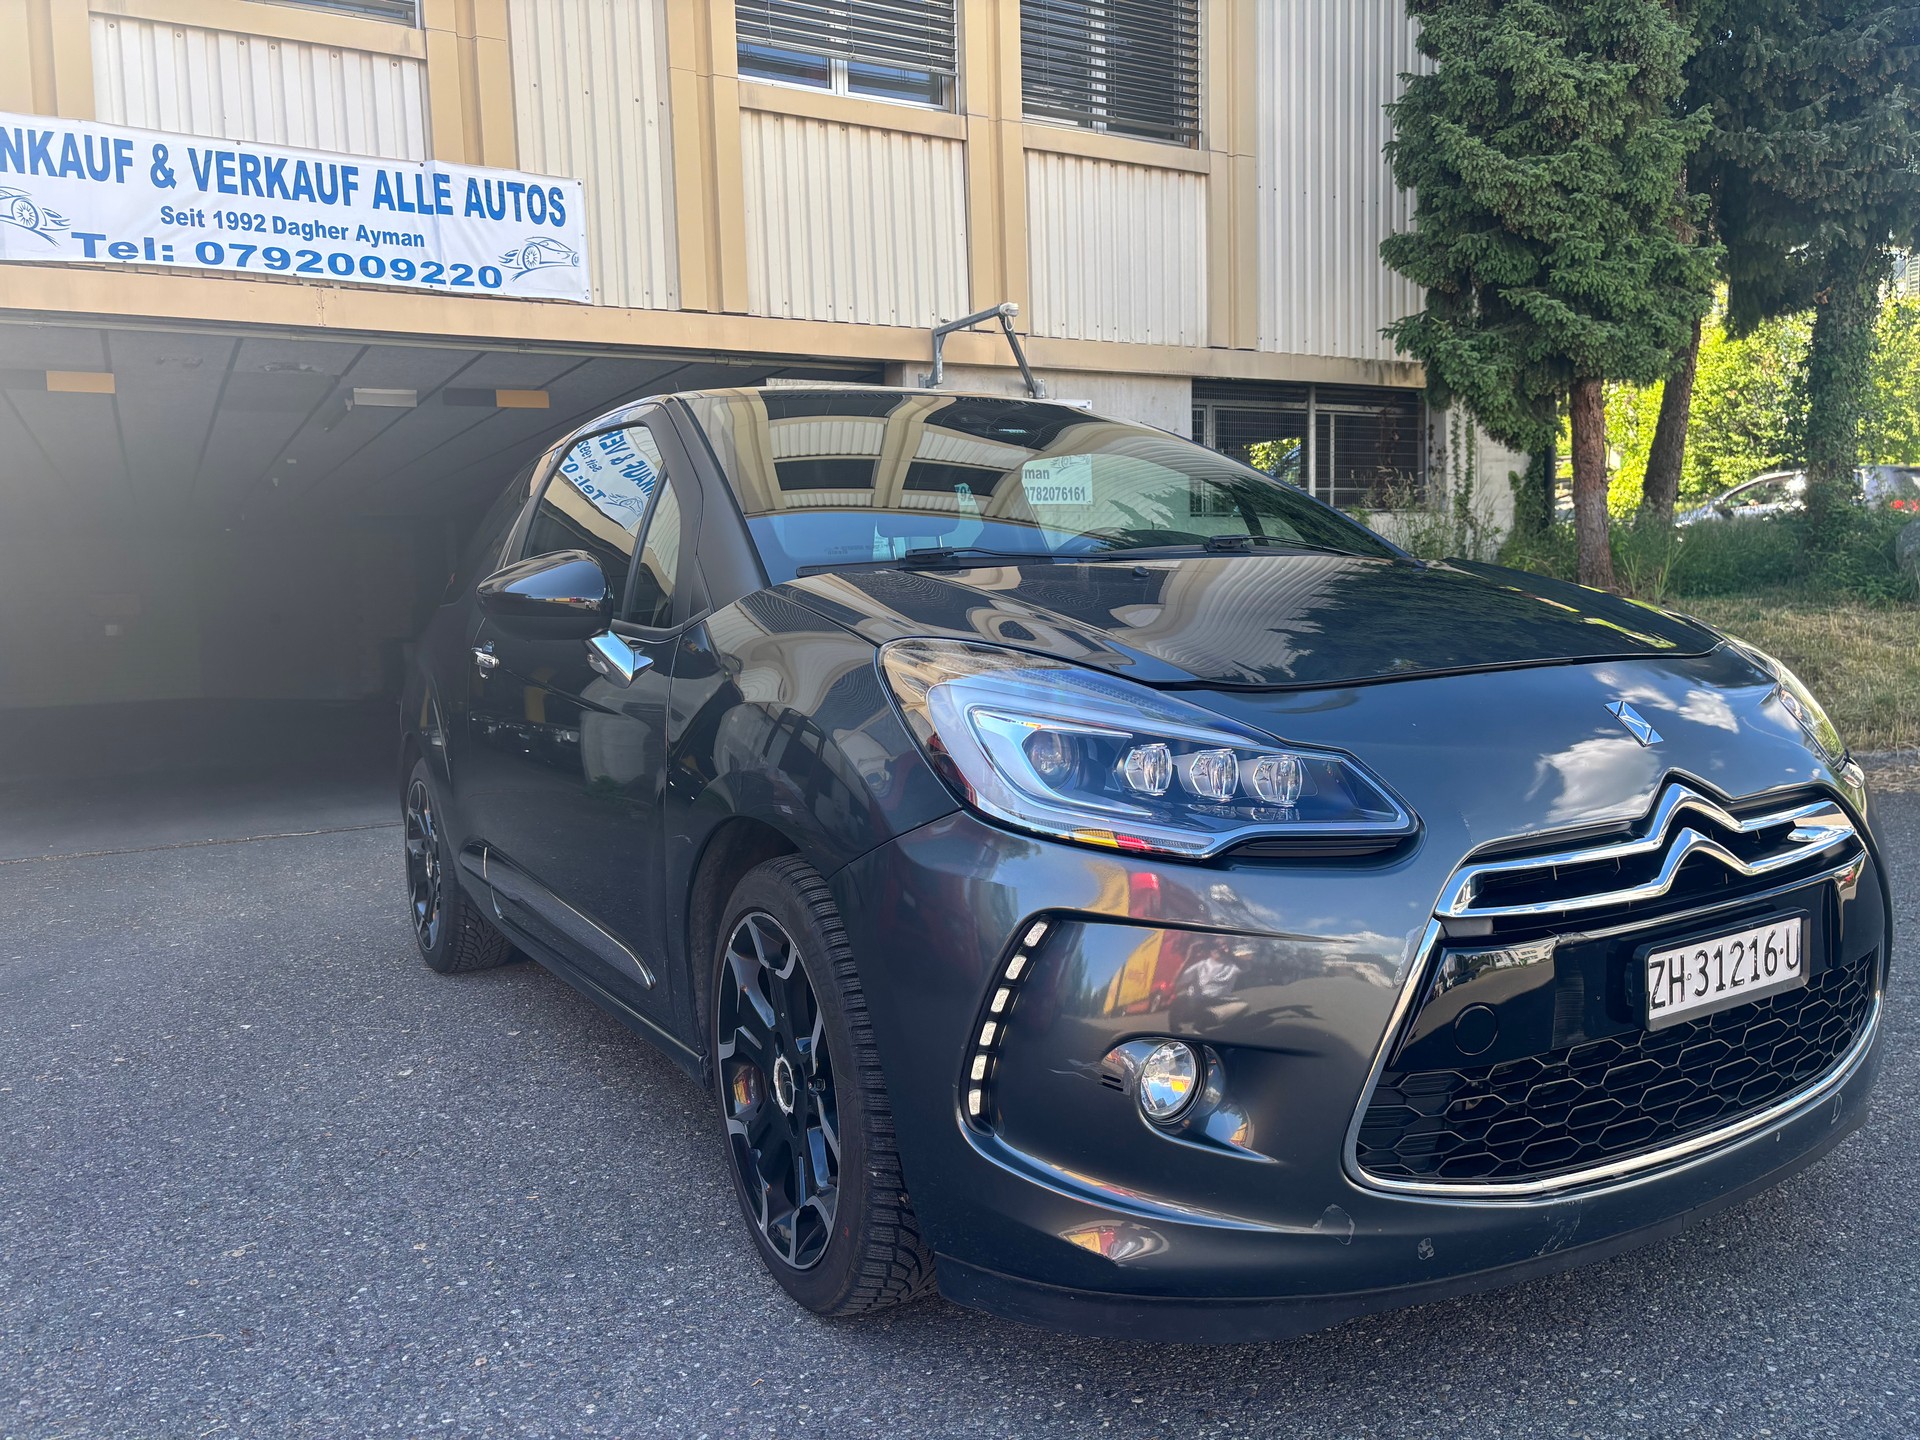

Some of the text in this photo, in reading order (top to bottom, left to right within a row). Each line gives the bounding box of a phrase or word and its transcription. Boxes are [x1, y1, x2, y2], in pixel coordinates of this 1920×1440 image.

[151, 144, 176, 189] &
[187, 147, 359, 207] VERKAUF
[372, 169, 455, 216] ALLE
[463, 177, 567, 228] AUTOS
[160, 205, 425, 248] Seit 1992 Dagher Ayman
[70, 231, 503, 289] Tel: 0792009220
[1023, 468, 1050, 479] man
